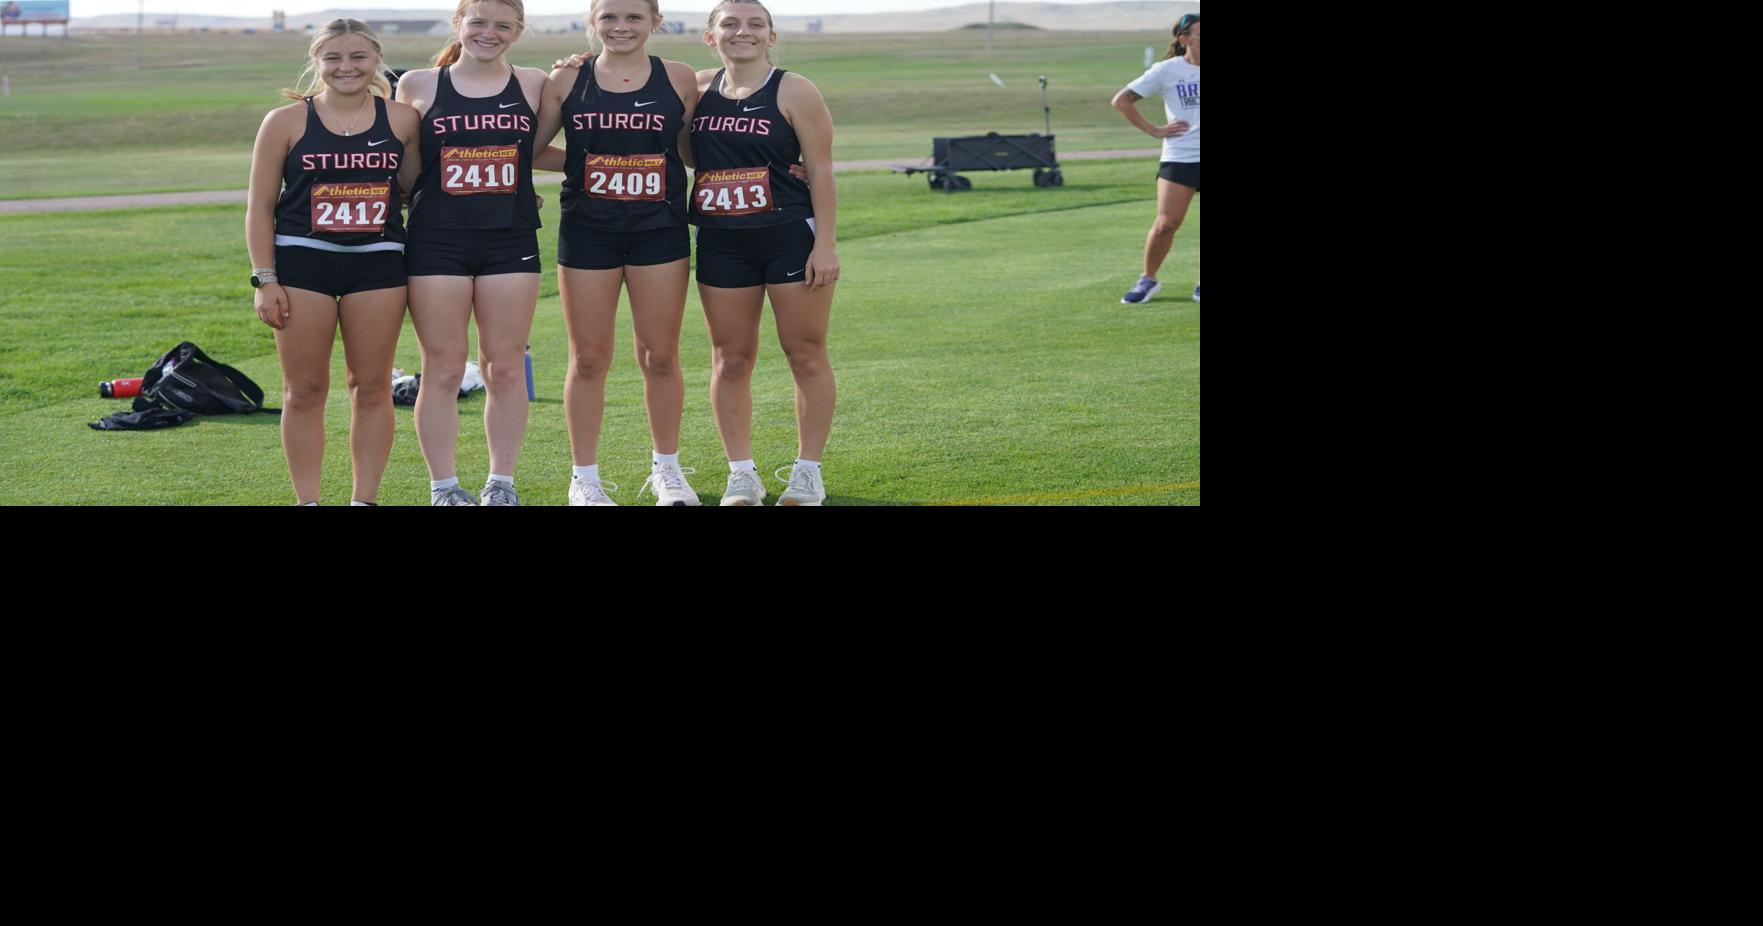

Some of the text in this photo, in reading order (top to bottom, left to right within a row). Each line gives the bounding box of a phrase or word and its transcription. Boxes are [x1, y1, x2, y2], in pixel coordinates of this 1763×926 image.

[433, 114, 530, 134] STURGIS
[573, 113, 664, 131] STURGIS
[691, 116, 771, 135] STURGIS
[302, 153, 398, 170] STURGIS
[446, 163, 516, 188] 2410
[589, 171, 661, 196] 2409
[699, 185, 767, 211] 2413
[316, 201, 387, 226] 2412
